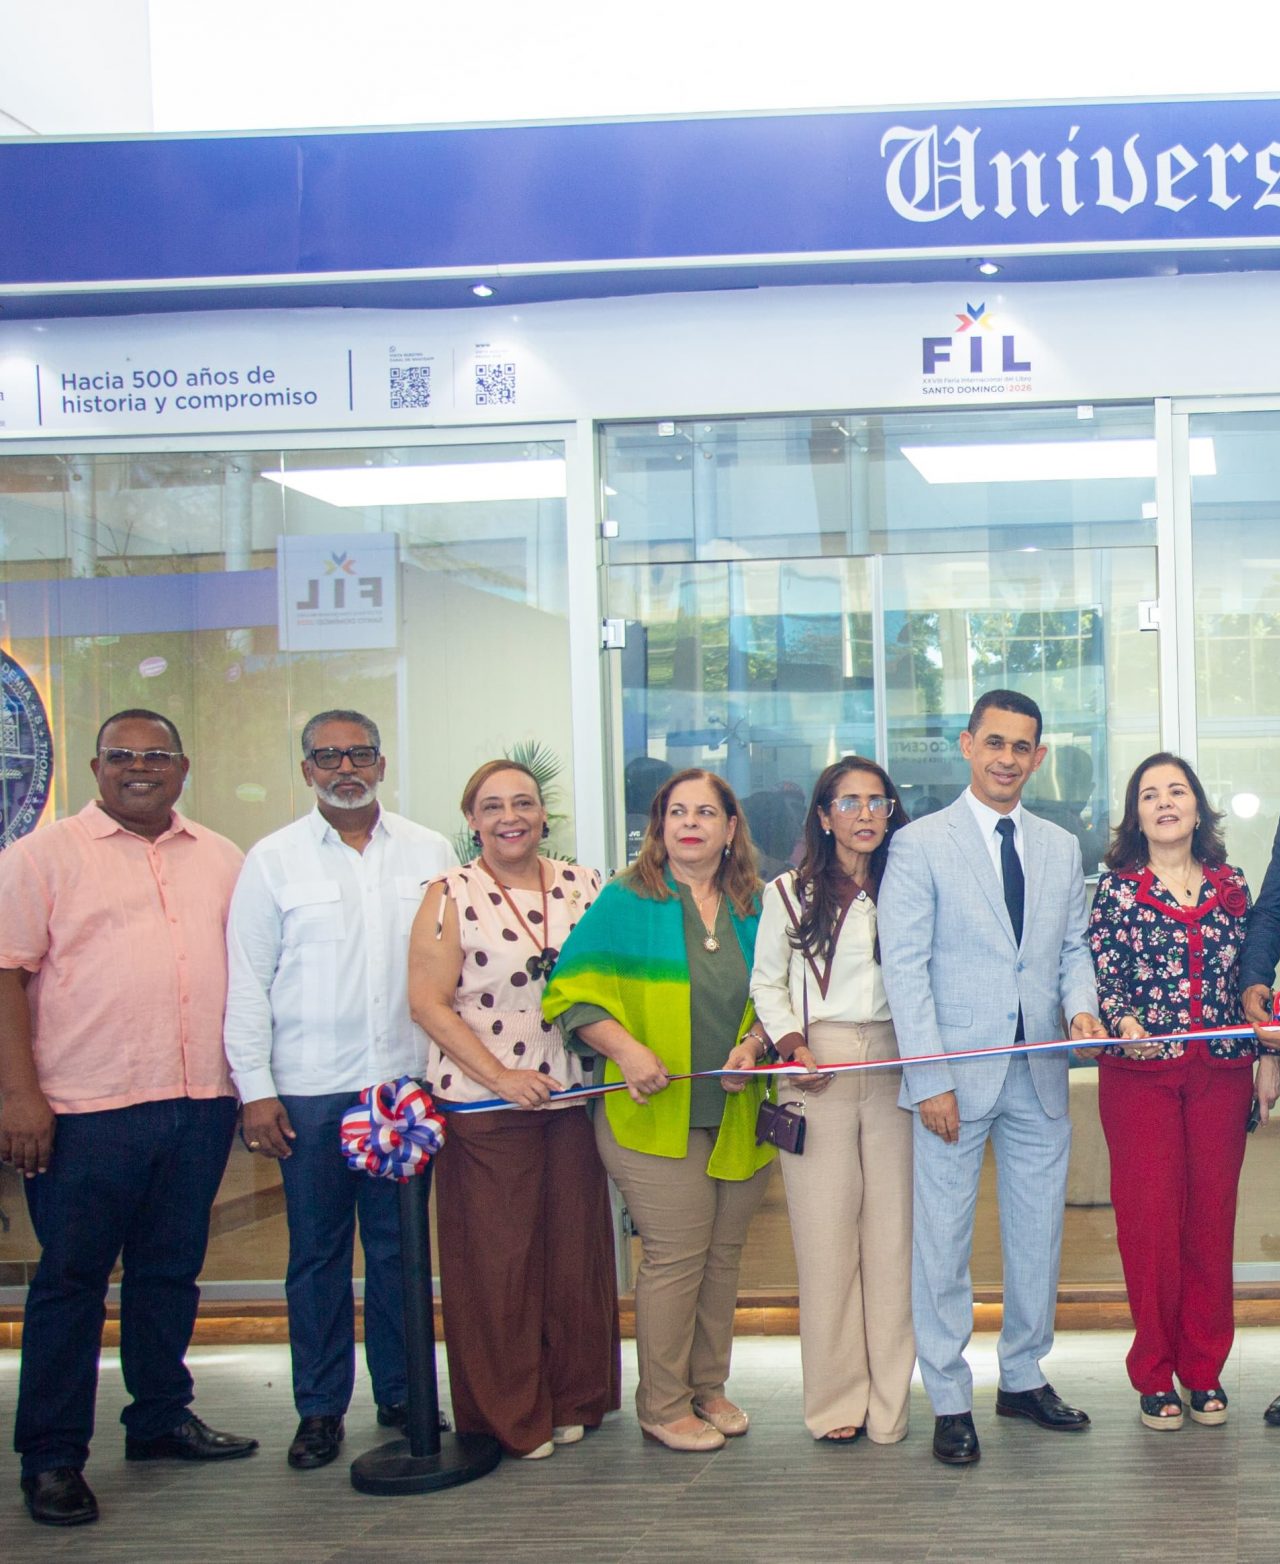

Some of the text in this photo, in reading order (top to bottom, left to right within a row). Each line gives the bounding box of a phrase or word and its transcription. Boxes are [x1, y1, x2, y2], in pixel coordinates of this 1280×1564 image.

[922, 335, 1032, 375] FIL
[61, 365, 275, 391] Hacia 500 años de
[922, 384, 1032, 395] SANTO DOMINGO 2026
[62, 387, 318, 414] historia y compromiso
[0, 662, 32, 700] DEMIA
